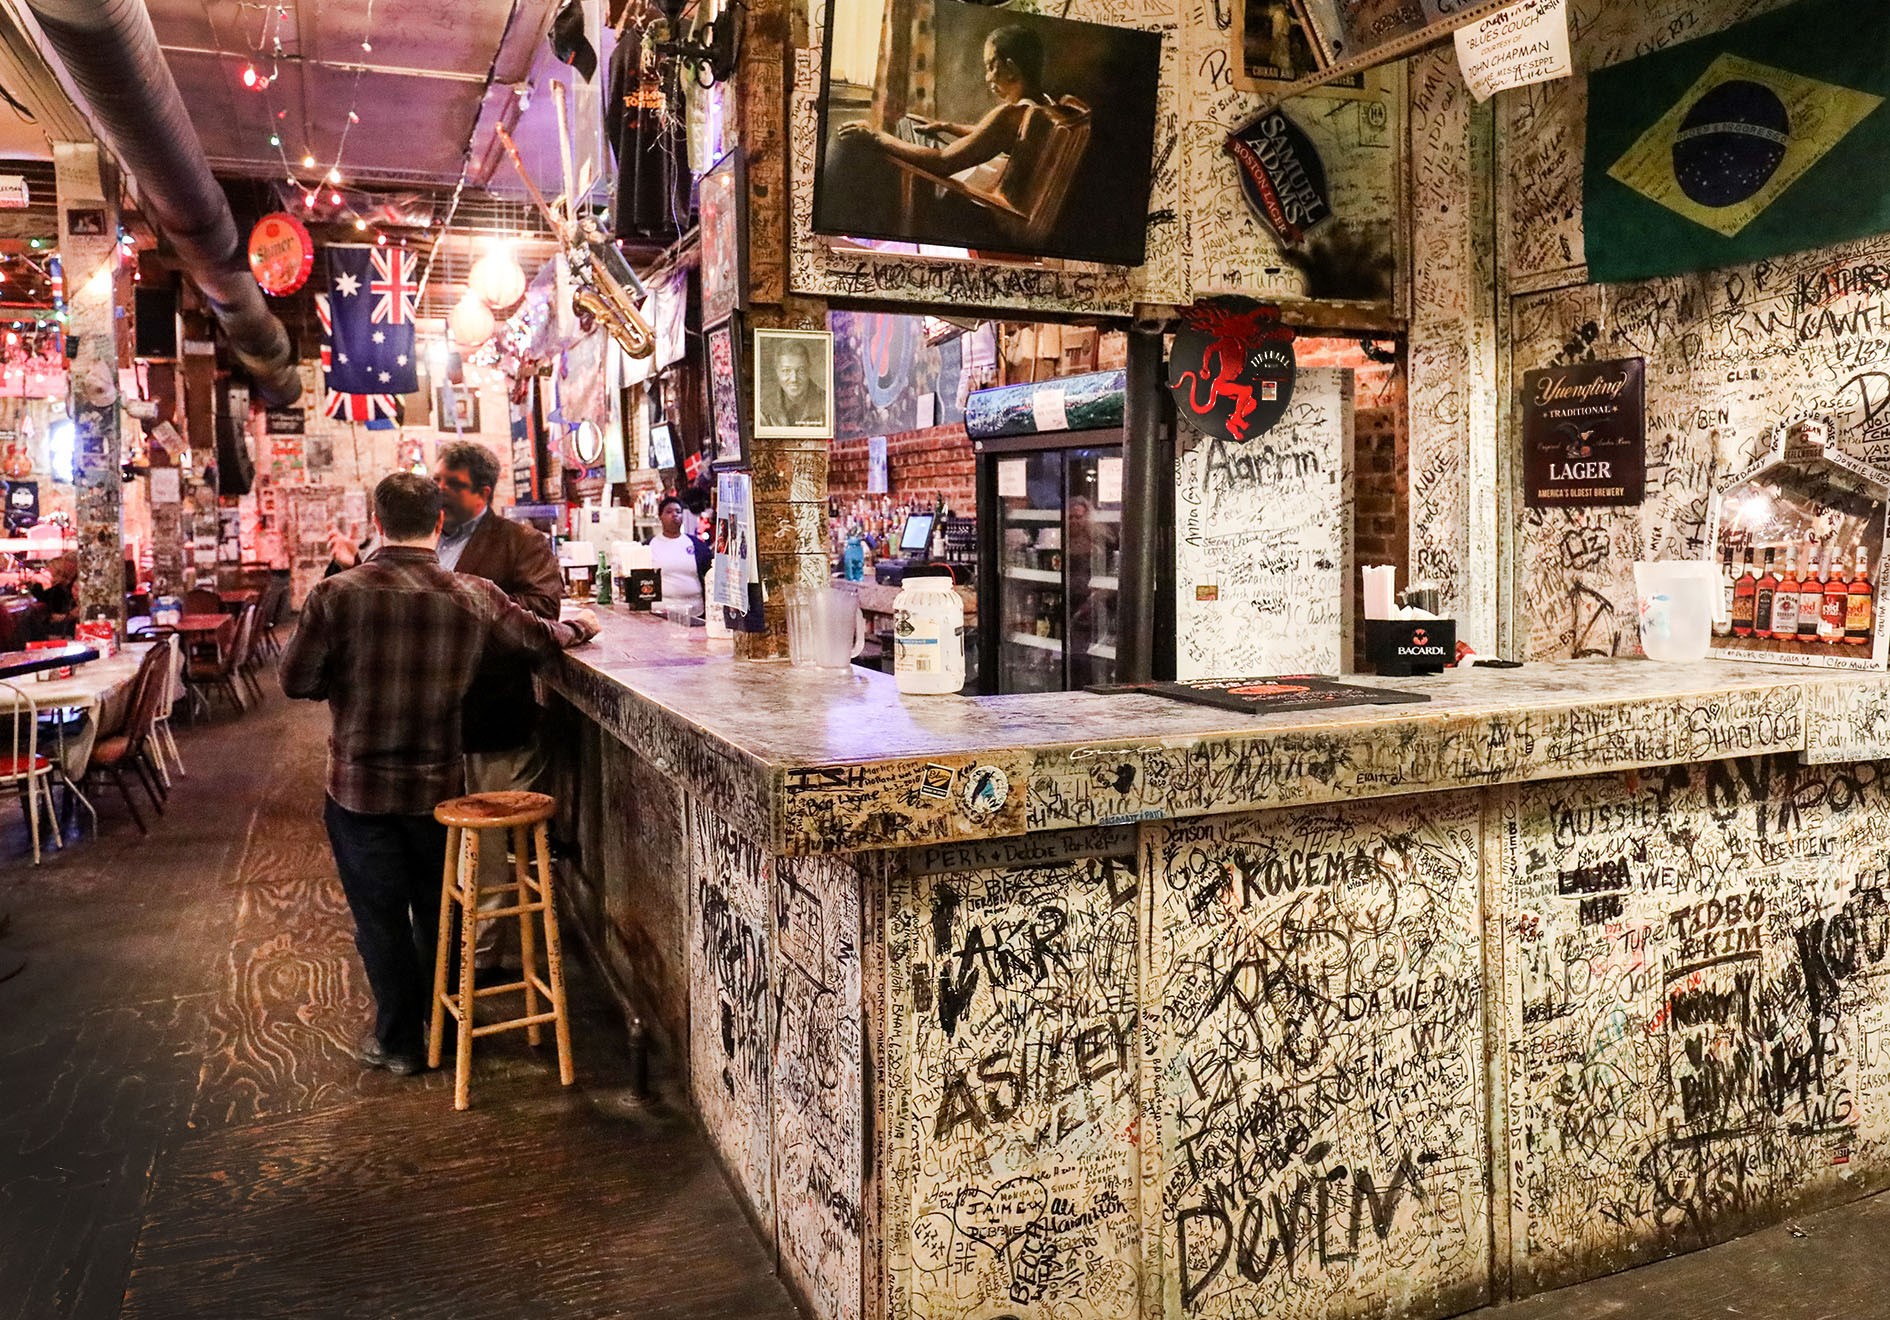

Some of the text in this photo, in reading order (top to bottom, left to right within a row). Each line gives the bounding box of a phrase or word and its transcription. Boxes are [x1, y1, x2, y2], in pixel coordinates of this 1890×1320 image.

[1491, 40, 1550, 67] CHAPMAN
[1247, 138, 1304, 225] ADAMS
[1261, 115, 1324, 224] SAMUEL
[1234, 142, 1288, 234] BOSTON LAGER
[1535, 371, 1627, 406] Yuengling
[1549, 405, 1611, 418] TRADITIONAL
[1697, 407, 1729, 430] BEN
[1803, 410, 1820, 421] SUE
[1550, 461, 1612, 481] LAGER
[1833, 454, 1867, 476] DONNIE
[1538, 487, 1625, 498] AMERICA'S OLDEST BREWERY
[1185, 507, 1201, 547] Anna
[1398, 646, 1443, 655] BACARDI
[1703, 924, 1764, 958] KIM
[1513, 1160, 1526, 1213] 2014
